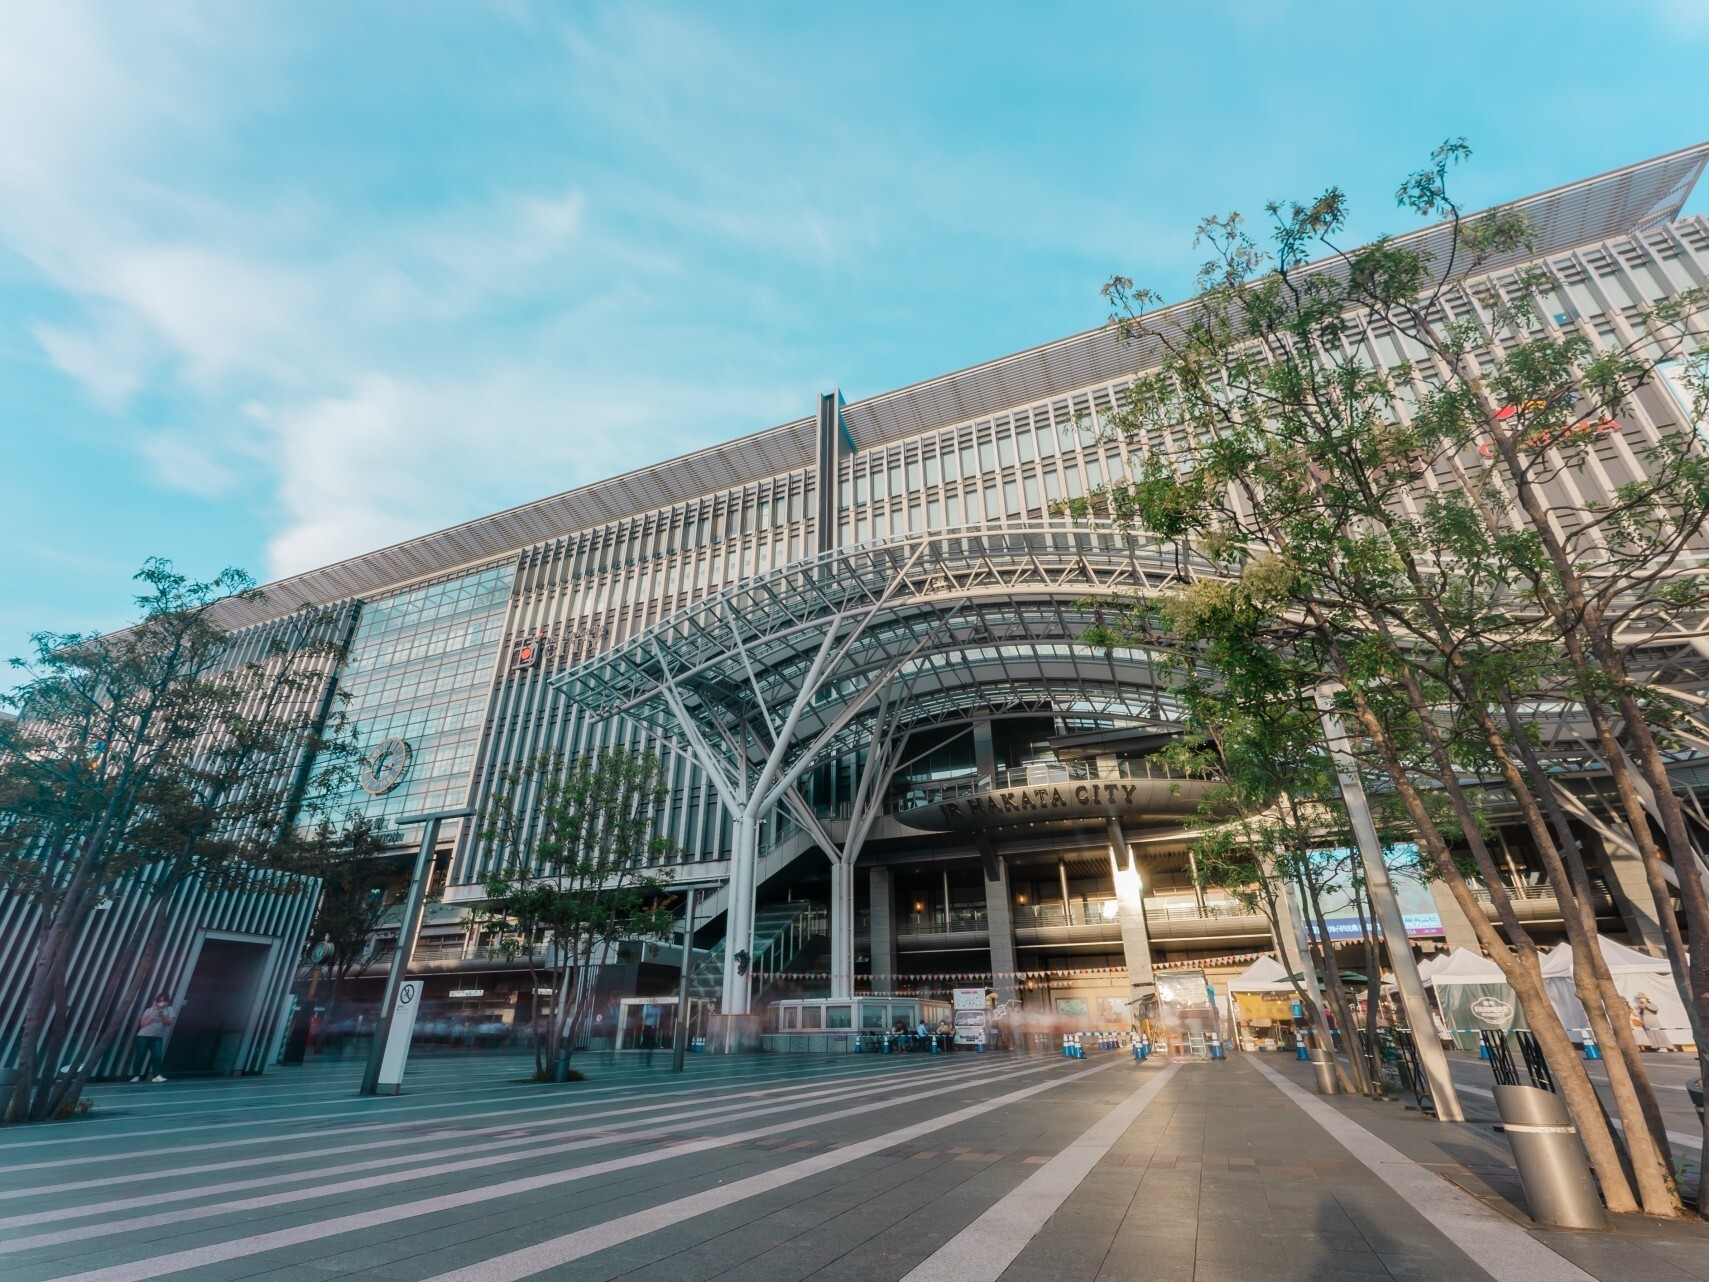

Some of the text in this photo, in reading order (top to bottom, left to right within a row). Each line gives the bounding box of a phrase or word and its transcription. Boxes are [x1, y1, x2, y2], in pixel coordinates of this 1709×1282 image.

[542, 632, 603, 659] CITY
[939, 784, 1137, 819] JR HAKATA CITY
